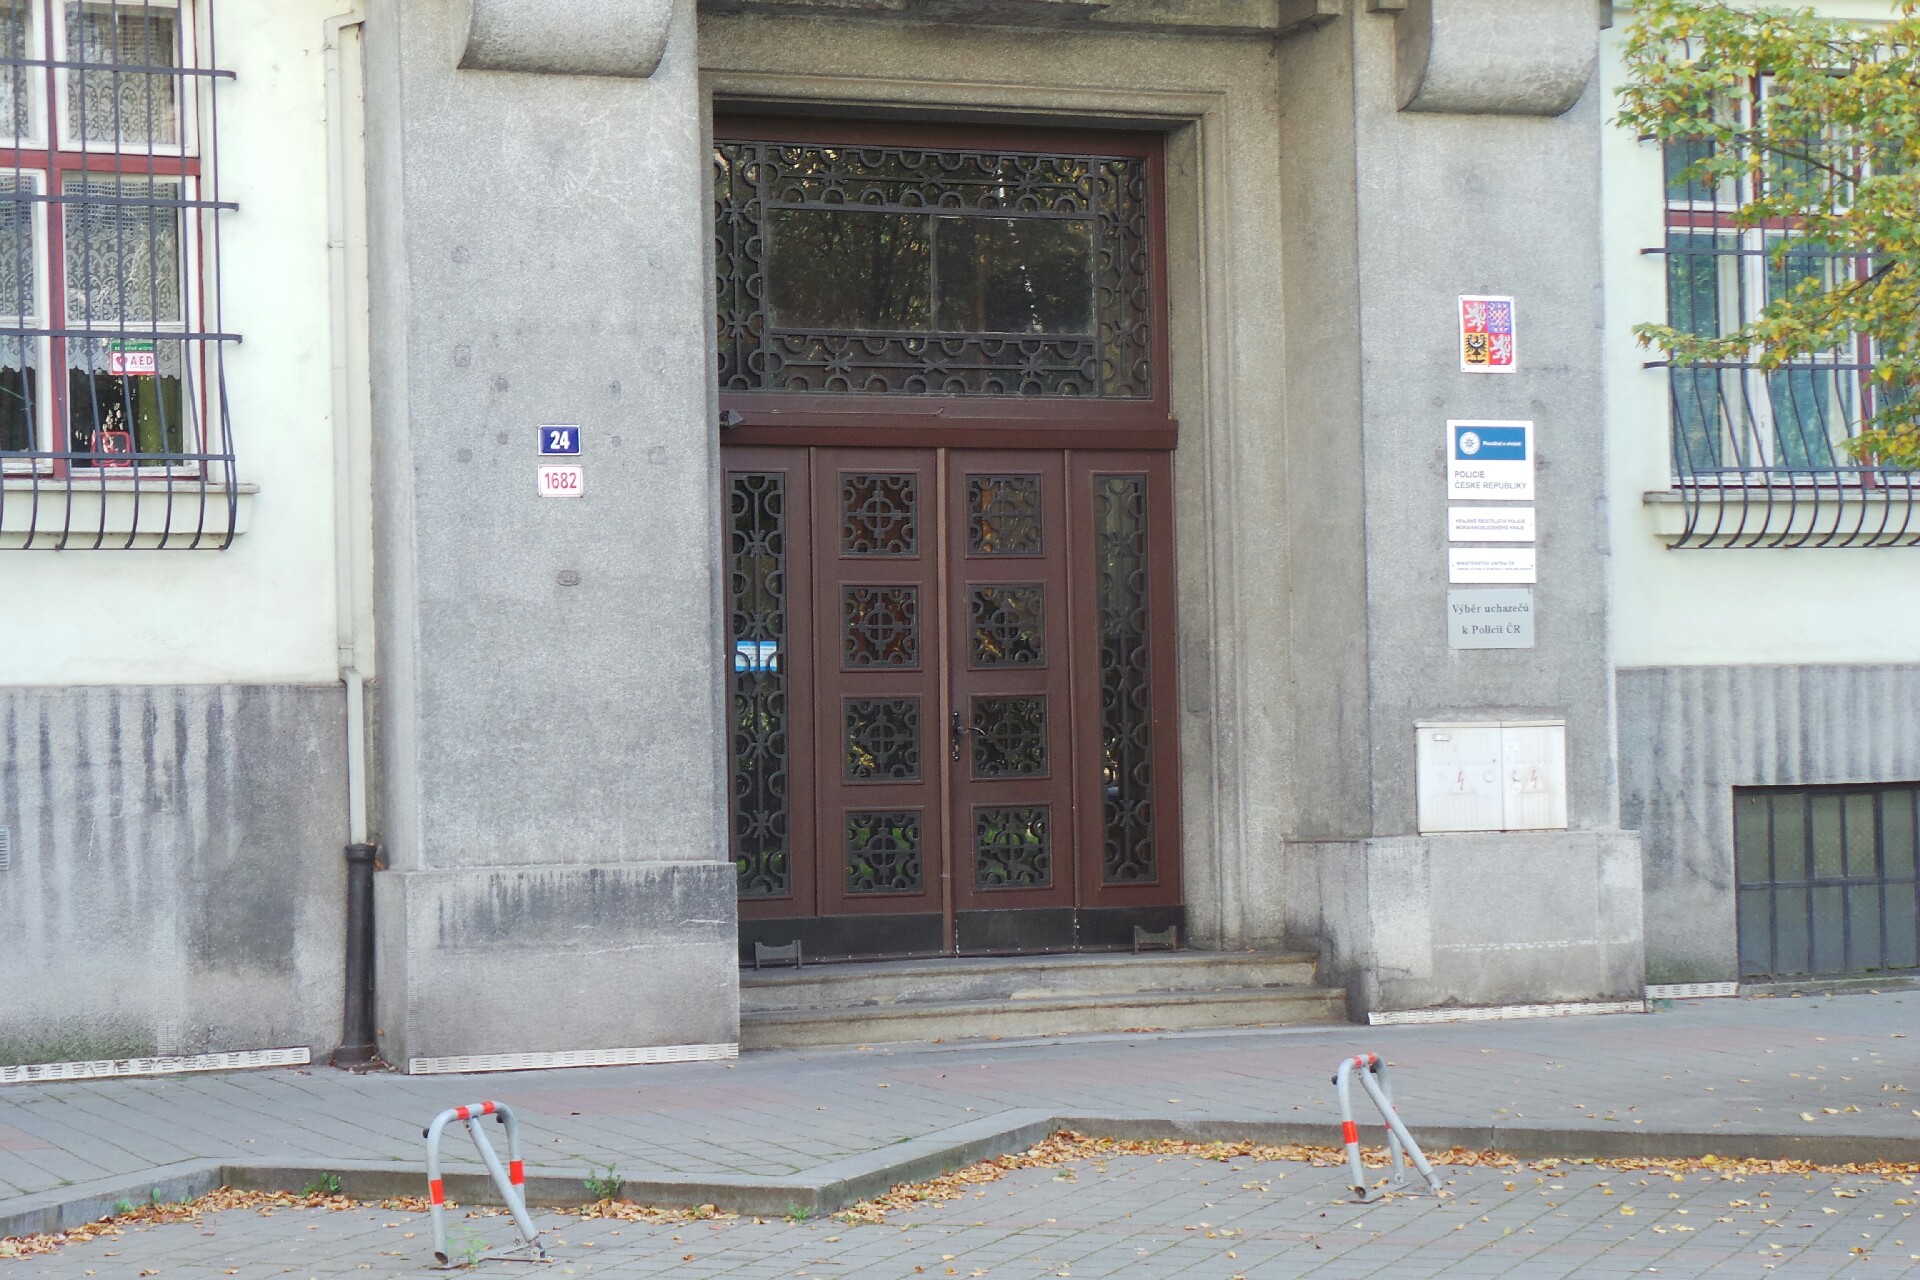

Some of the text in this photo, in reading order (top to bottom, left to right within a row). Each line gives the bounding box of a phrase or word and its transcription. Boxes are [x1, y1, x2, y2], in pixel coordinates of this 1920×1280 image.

[130, 356, 153, 365] AED
[550, 430, 570, 450] 24
[544, 472, 577, 489] 1682
[1454, 480, 1527, 489] ČESKÉ REPUBLIKY
[1452, 602, 1529, 615] Výběr uchazečů
[1461, 622, 1521, 635] k Policii ČR
